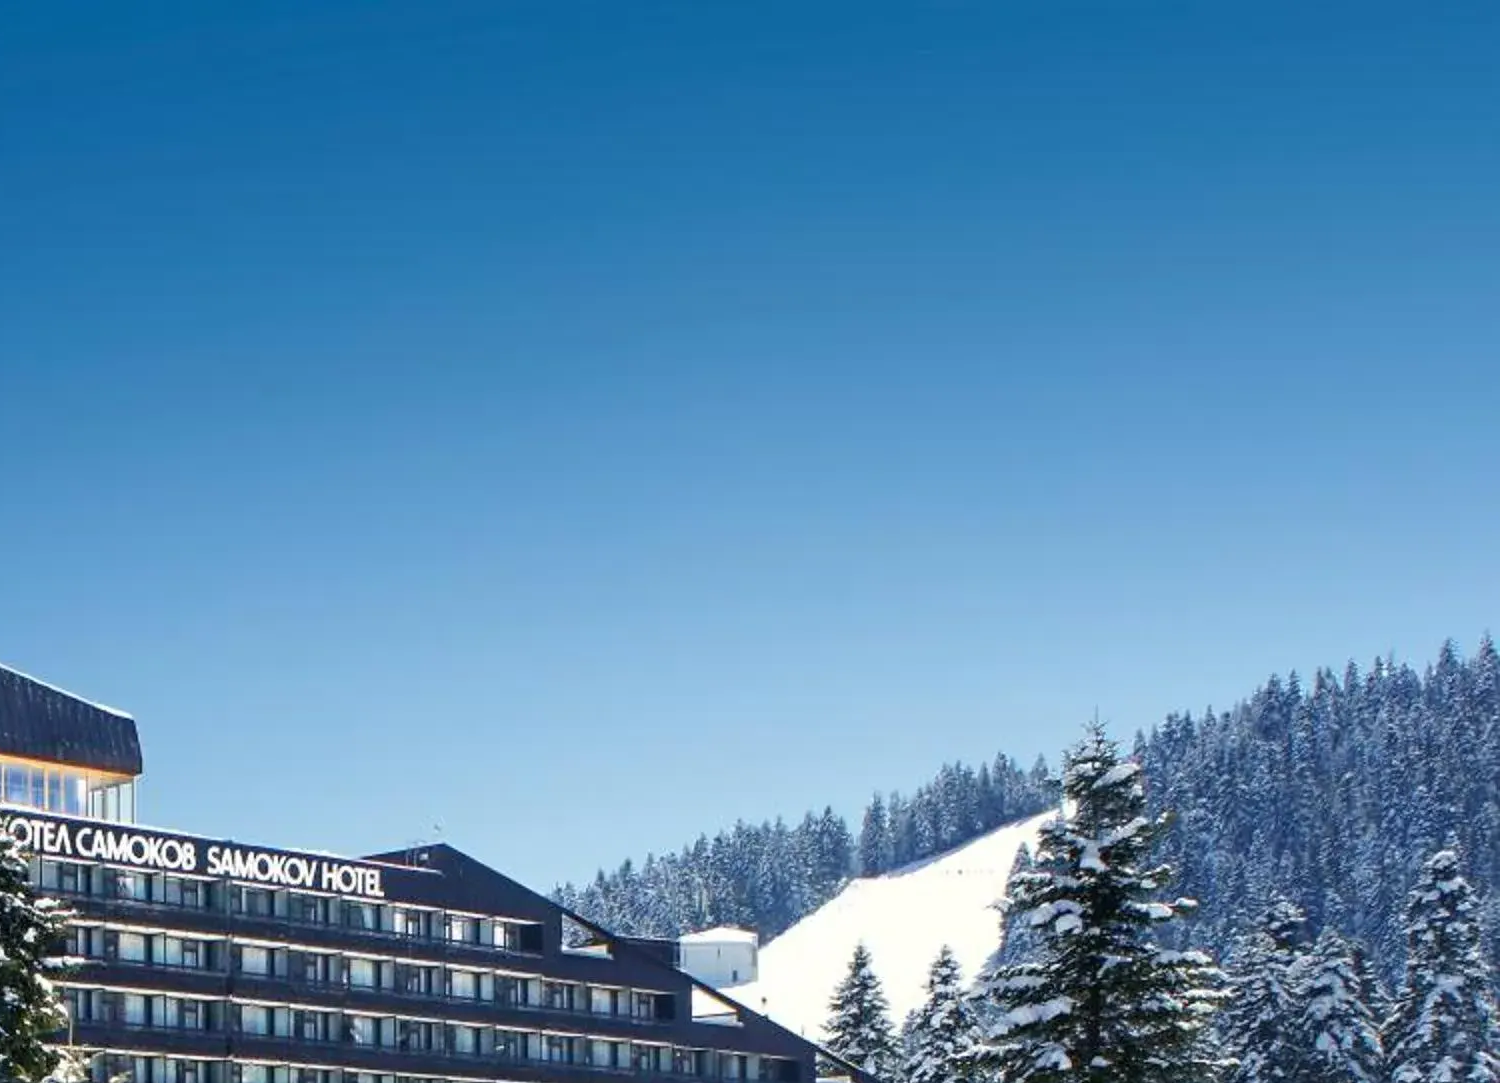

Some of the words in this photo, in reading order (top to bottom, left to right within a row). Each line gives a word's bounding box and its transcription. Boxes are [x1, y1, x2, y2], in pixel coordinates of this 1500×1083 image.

[76, 828, 196, 870] САМОКОВ
[207, 846, 318, 887] SAMOKOV
[322, 863, 385, 897] HOTEL
